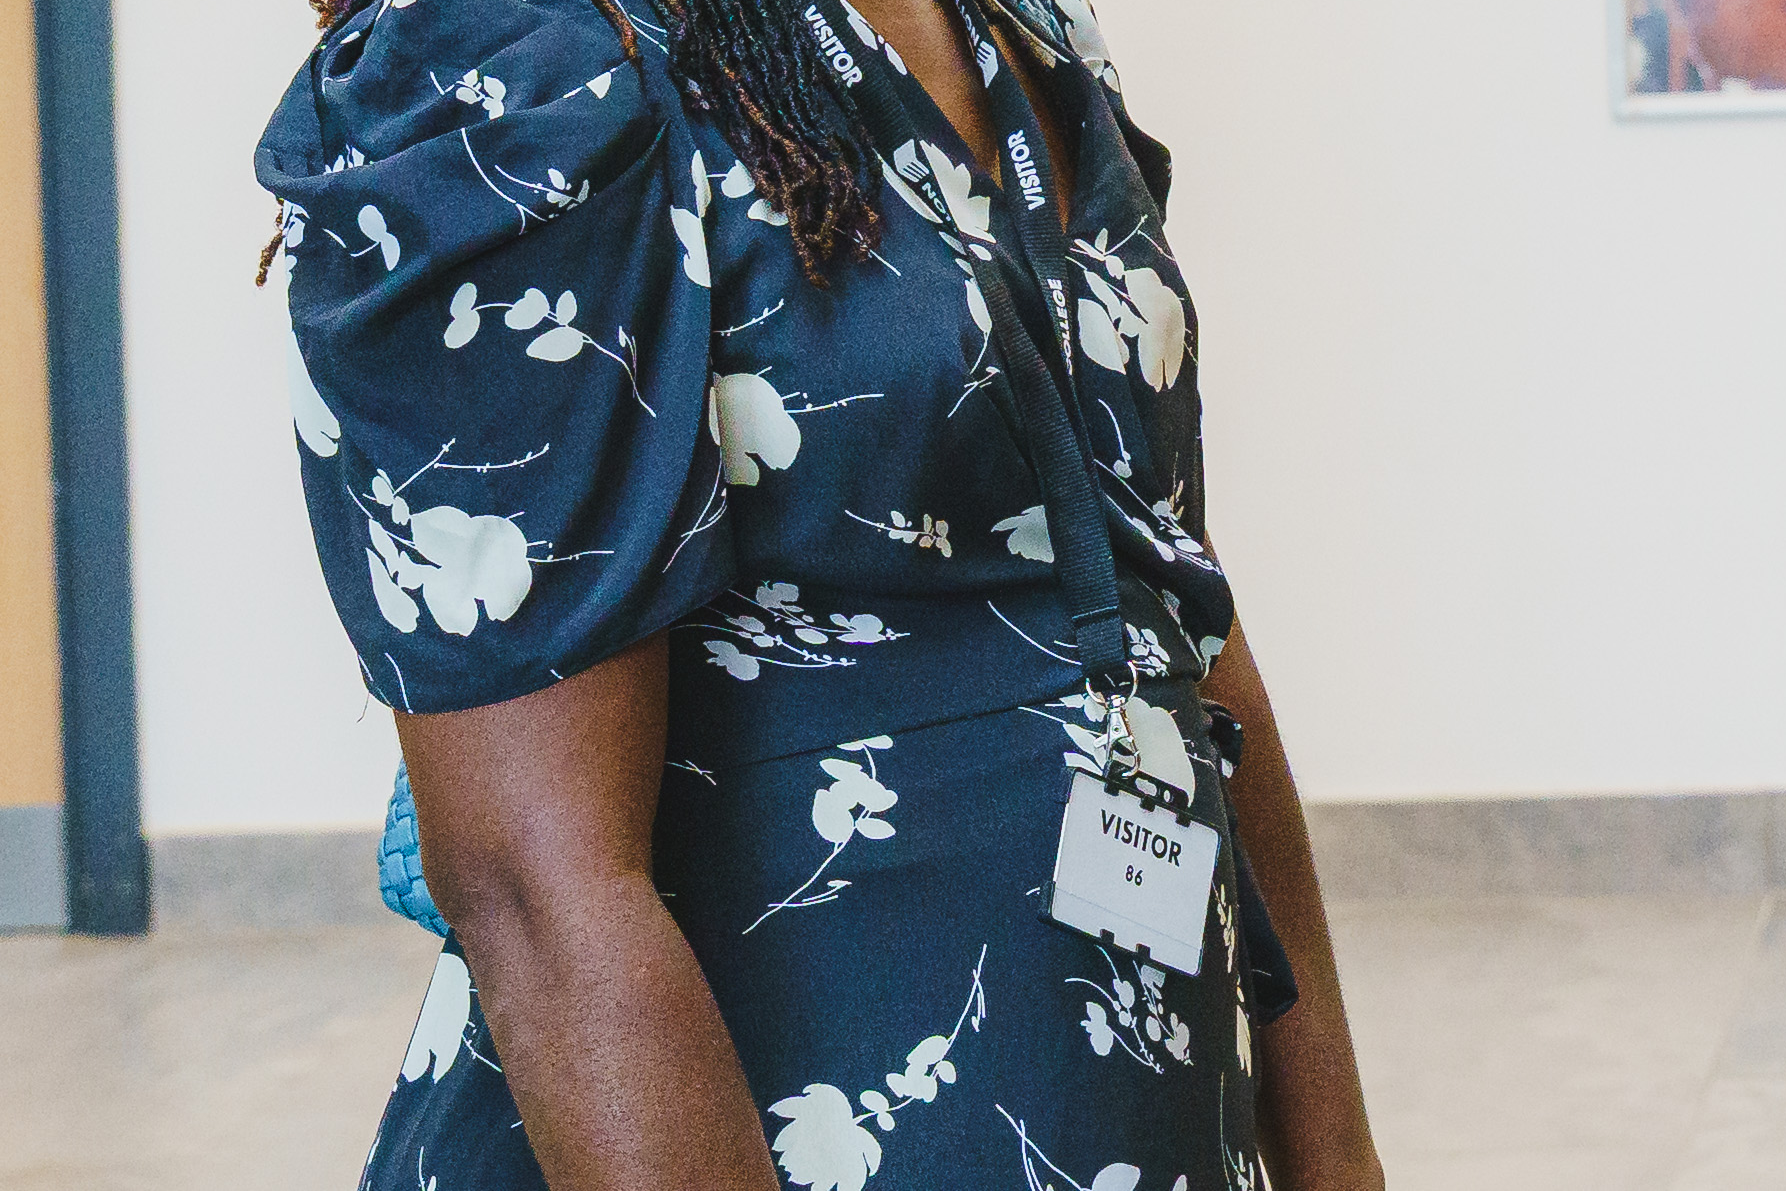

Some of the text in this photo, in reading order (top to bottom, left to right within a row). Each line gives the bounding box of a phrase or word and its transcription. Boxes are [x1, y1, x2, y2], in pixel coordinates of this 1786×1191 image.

[804, 4, 863, 88] VISITOR
[1007, 129, 1046, 211] VISITOR
[1101, 809, 1182, 867] VISITOR
[1125, 864, 1144, 887] 86
